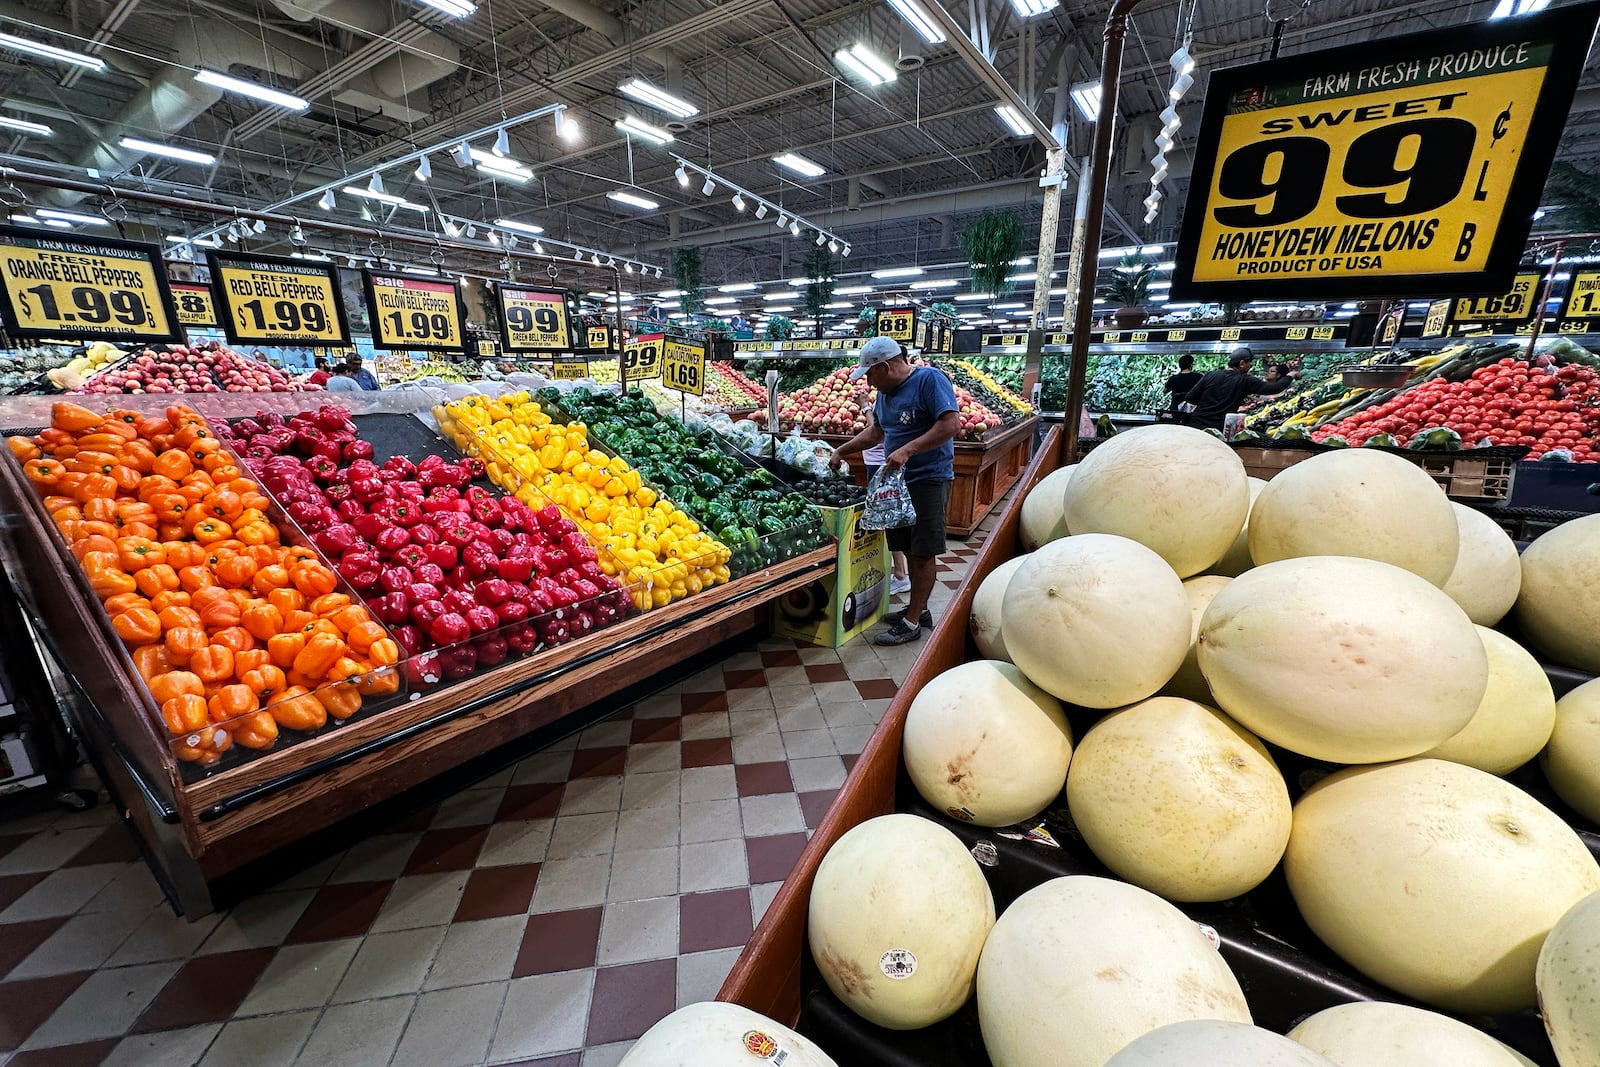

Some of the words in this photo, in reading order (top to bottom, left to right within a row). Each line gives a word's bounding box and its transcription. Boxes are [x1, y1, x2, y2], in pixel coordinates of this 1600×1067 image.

[1302, 71, 1350, 98] FARM
[1356, 61, 1420, 90] FRESH
[1427, 42, 1530, 78] PRODUCE
[1259, 91, 1468, 136] SWEET
[1213, 117, 1477, 229] 99
[1212, 225, 1337, 261] HONEYDEW
[1335, 217, 1440, 254] MELONS
[36, 239, 63, 250] FARM
[66, 242, 97, 254] FRESH
[99, 246, 142, 259] PRODUCE
[38, 253, 105, 267] FRESH
[1236, 259, 1315, 275] PRODUCT
[1318, 257, 1341, 271] OF
[1345, 254, 1382, 270] USA
[7, 258, 62, 282] ORANGE
[62, 264, 93, 284] BELL
[93, 266, 143, 289] PEPPERS
[251, 273, 298, 283] FRESH
[270, 264, 292, 273] FRESH
[293, 266, 325, 276] PRODUCE
[230, 279, 253, 296] RED
[255, 281, 281, 298] BELL
[281, 283, 325, 300] PEPPERS
[376, 277, 405, 287] sale
[395, 288, 431, 297] FRESH
[505, 290, 527, 299] sale
[379, 293, 406, 309] YELLOW
[406, 297, 422, 311] BELL
[422, 298, 450, 313] PEPPERS
[507, 306, 559, 333] 99
[880, 318, 908, 332] 88
[1427, 317, 1443, 333] 1.69
[60, 324, 103, 333] PRODUCT
[589, 332, 605, 342] 79
[513, 333, 527, 342] GREEN
[529, 334, 539, 342] BELL
[540, 334, 558, 343] PEPPERS
[624, 347, 657, 368] 99
[667, 348, 700, 365] CAULIFLOWER
